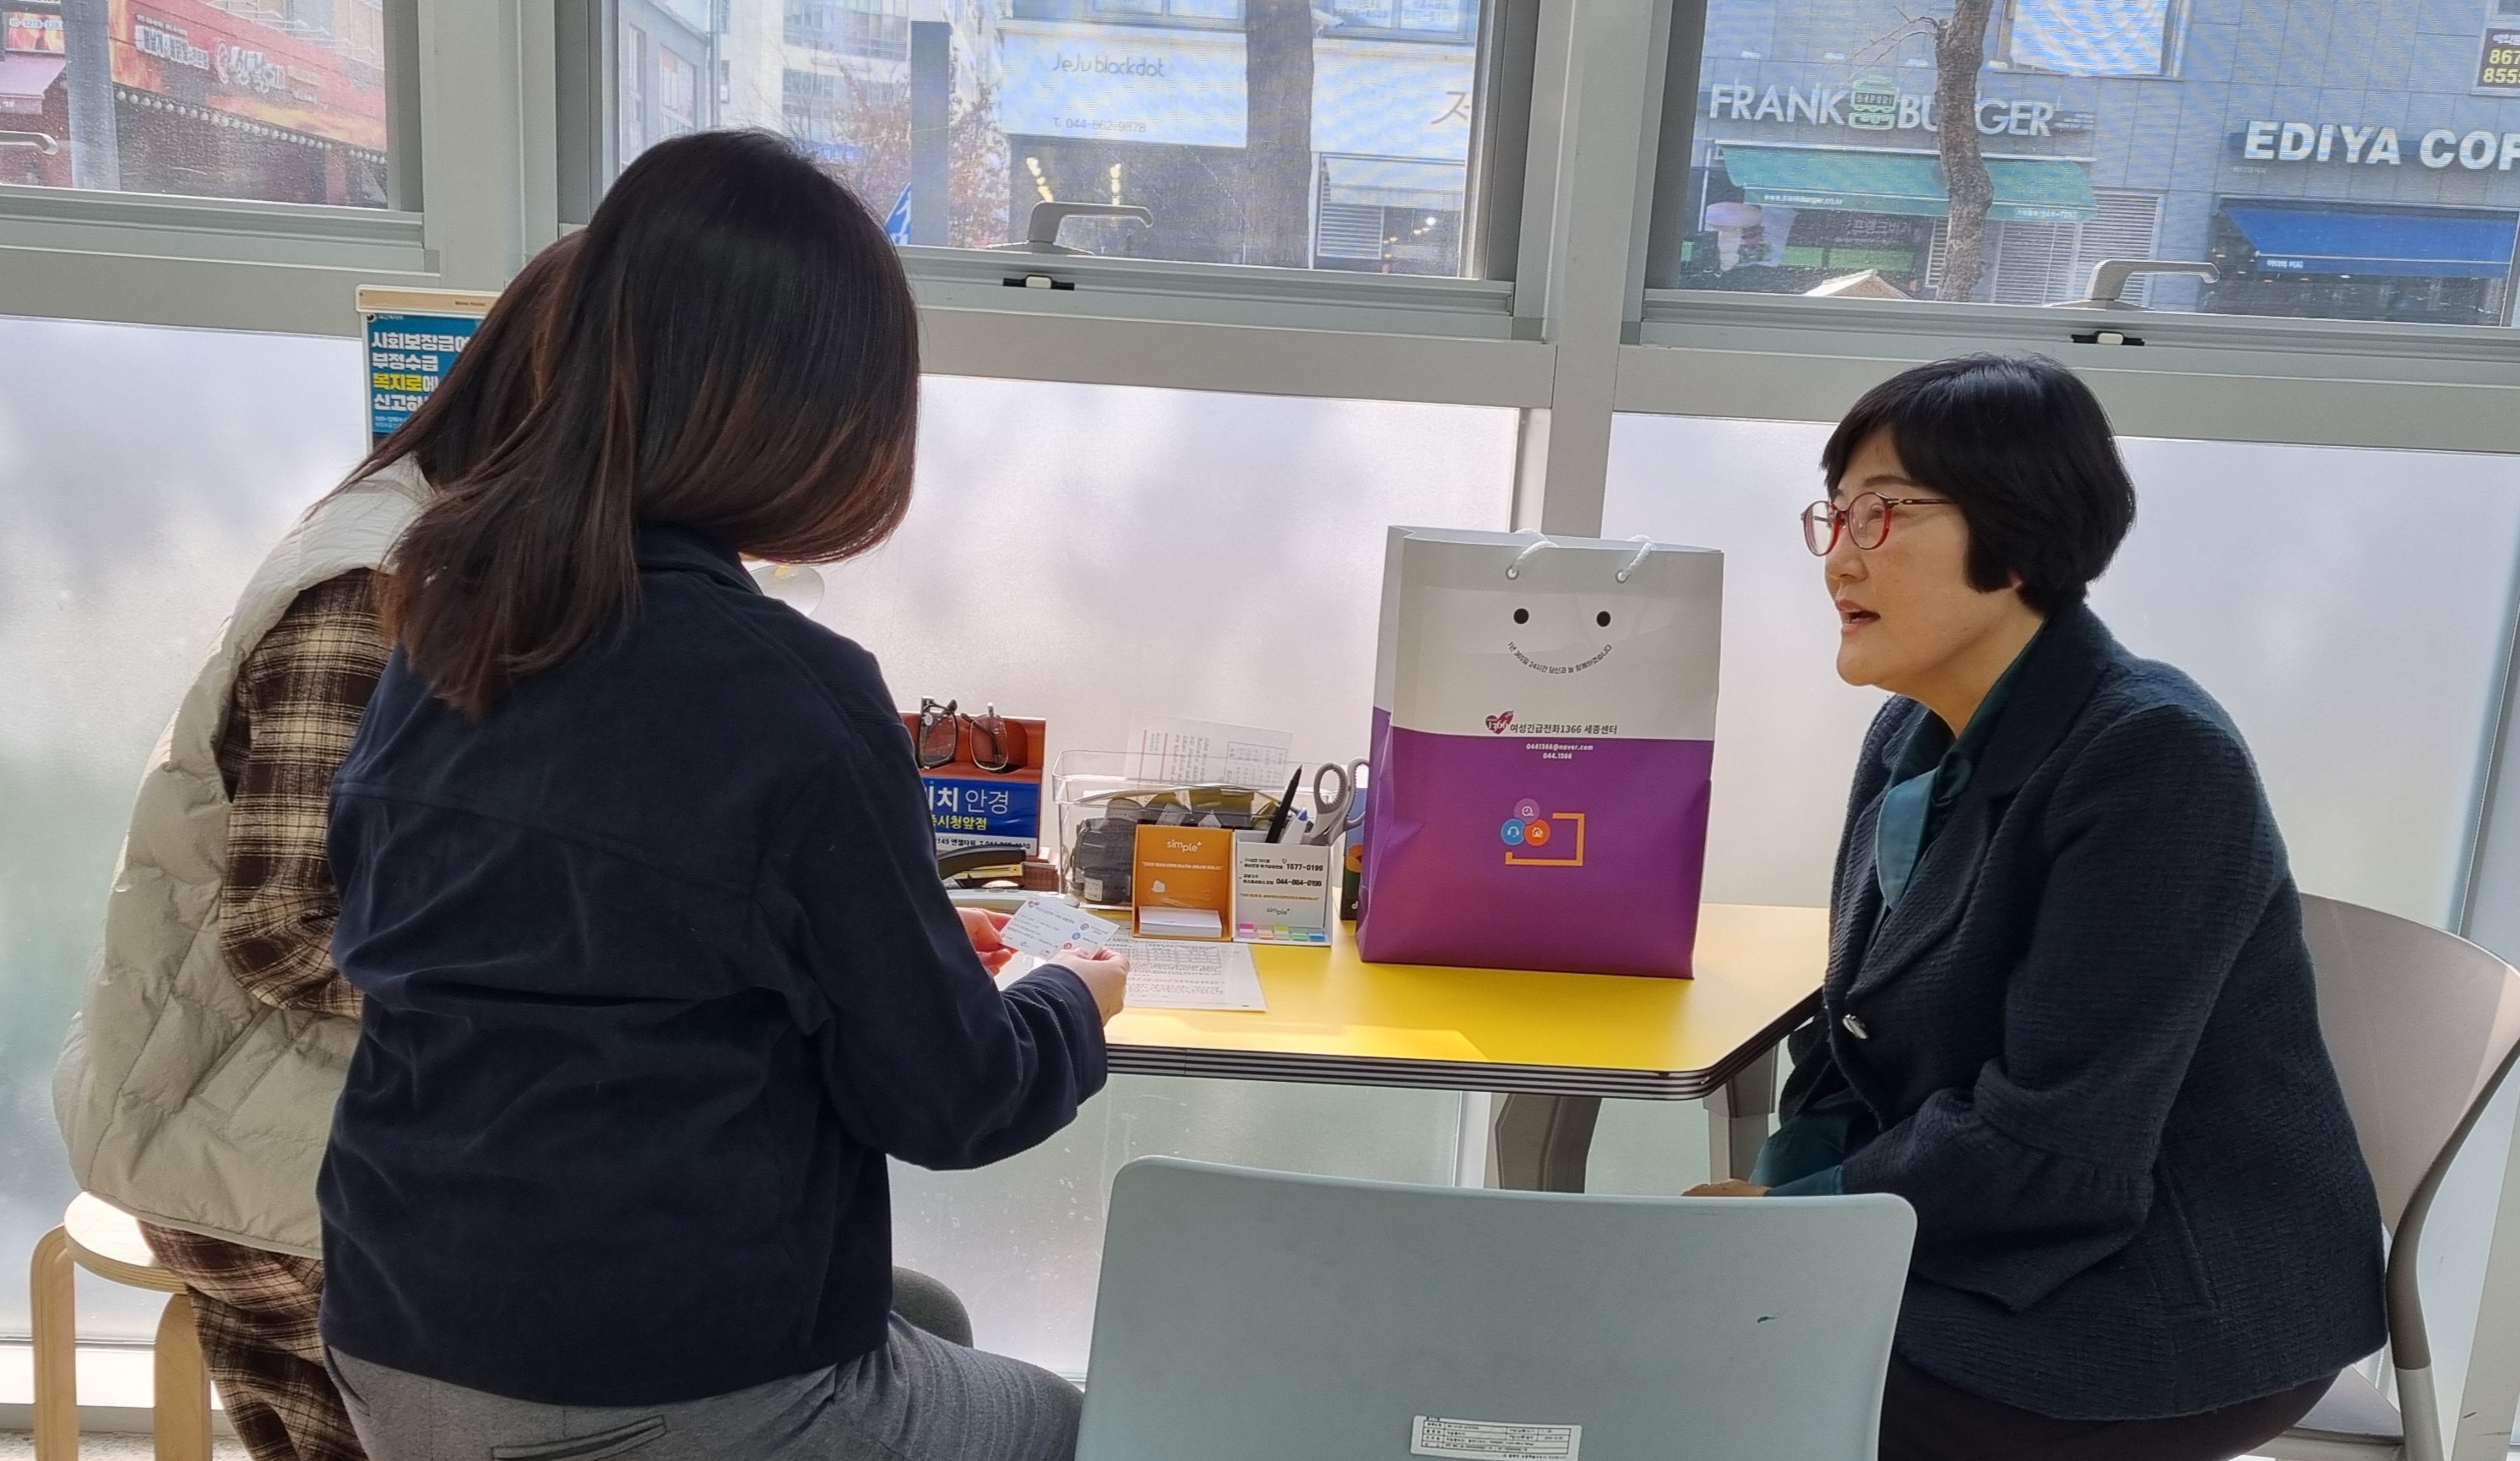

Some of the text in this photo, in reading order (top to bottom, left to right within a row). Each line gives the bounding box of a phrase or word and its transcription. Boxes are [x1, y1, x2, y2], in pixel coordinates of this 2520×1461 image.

[2483, 68, 2520, 84] 855
[1710, 81, 2055, 137] FRANK BUGER
[2244, 120, 2401, 166] EDIYA
[1510, 724, 1617, 735] 여성긴급전화1366 세종센터
[965, 789, 1009, 815] 안경
